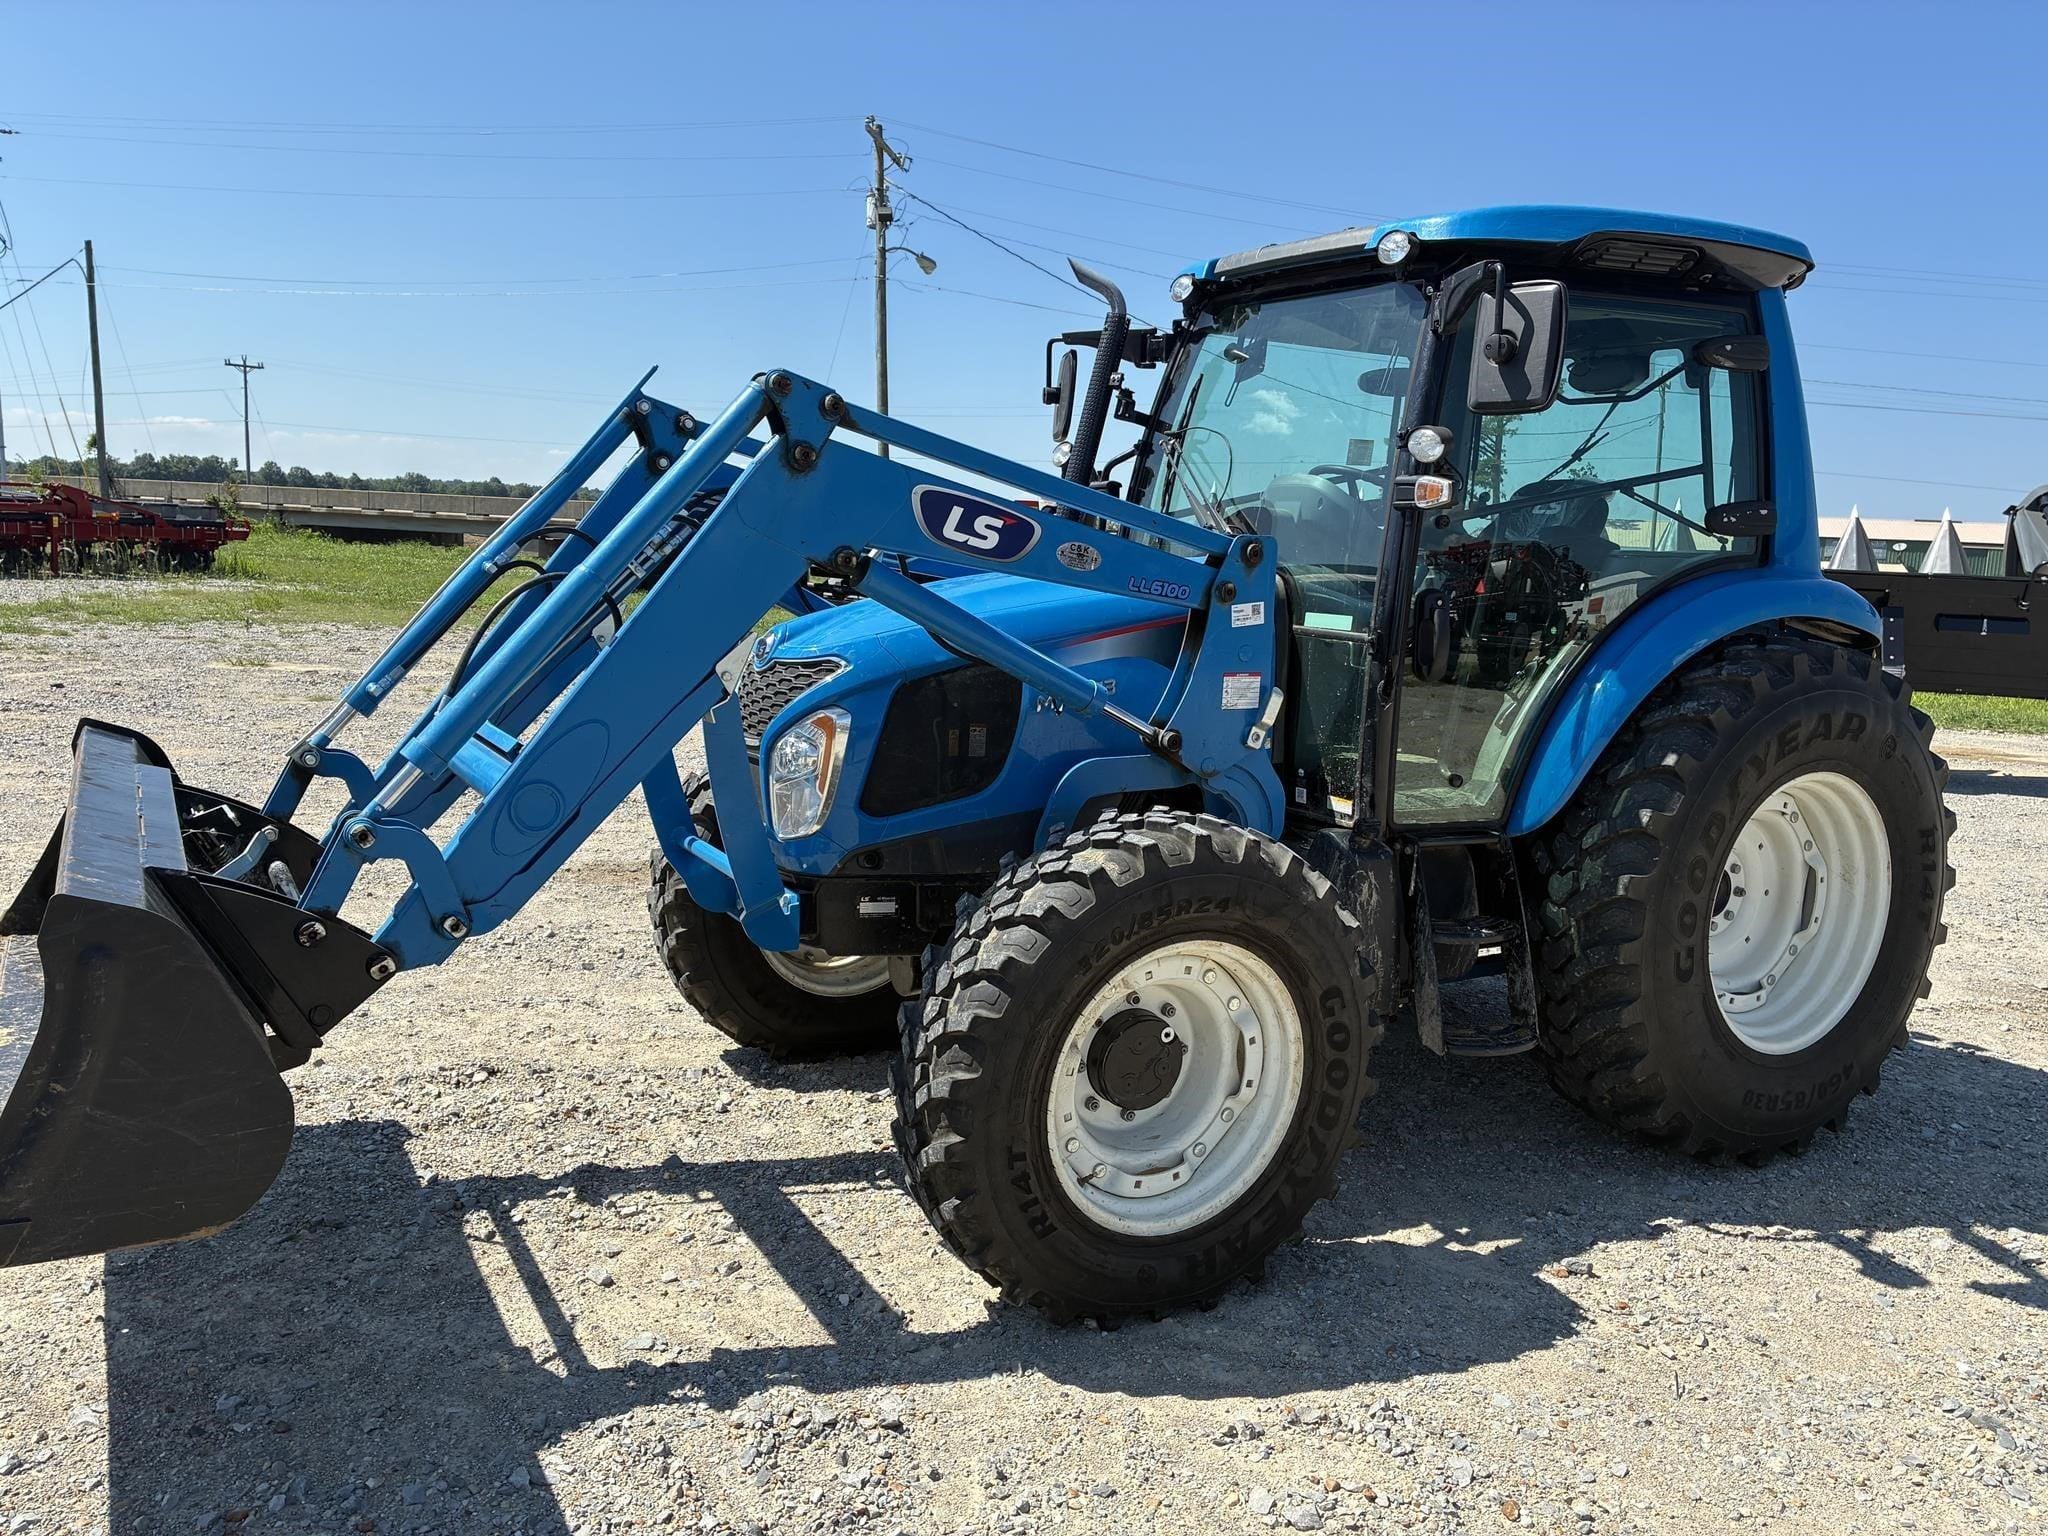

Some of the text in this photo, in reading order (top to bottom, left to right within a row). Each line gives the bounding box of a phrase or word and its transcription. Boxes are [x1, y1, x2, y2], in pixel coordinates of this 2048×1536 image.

[942, 505, 1004, 550] LS
[1070, 543, 1090, 555] C&K
[1128, 576, 1190, 600] LL6100
[1006, 1145, 1058, 1240] R14T
